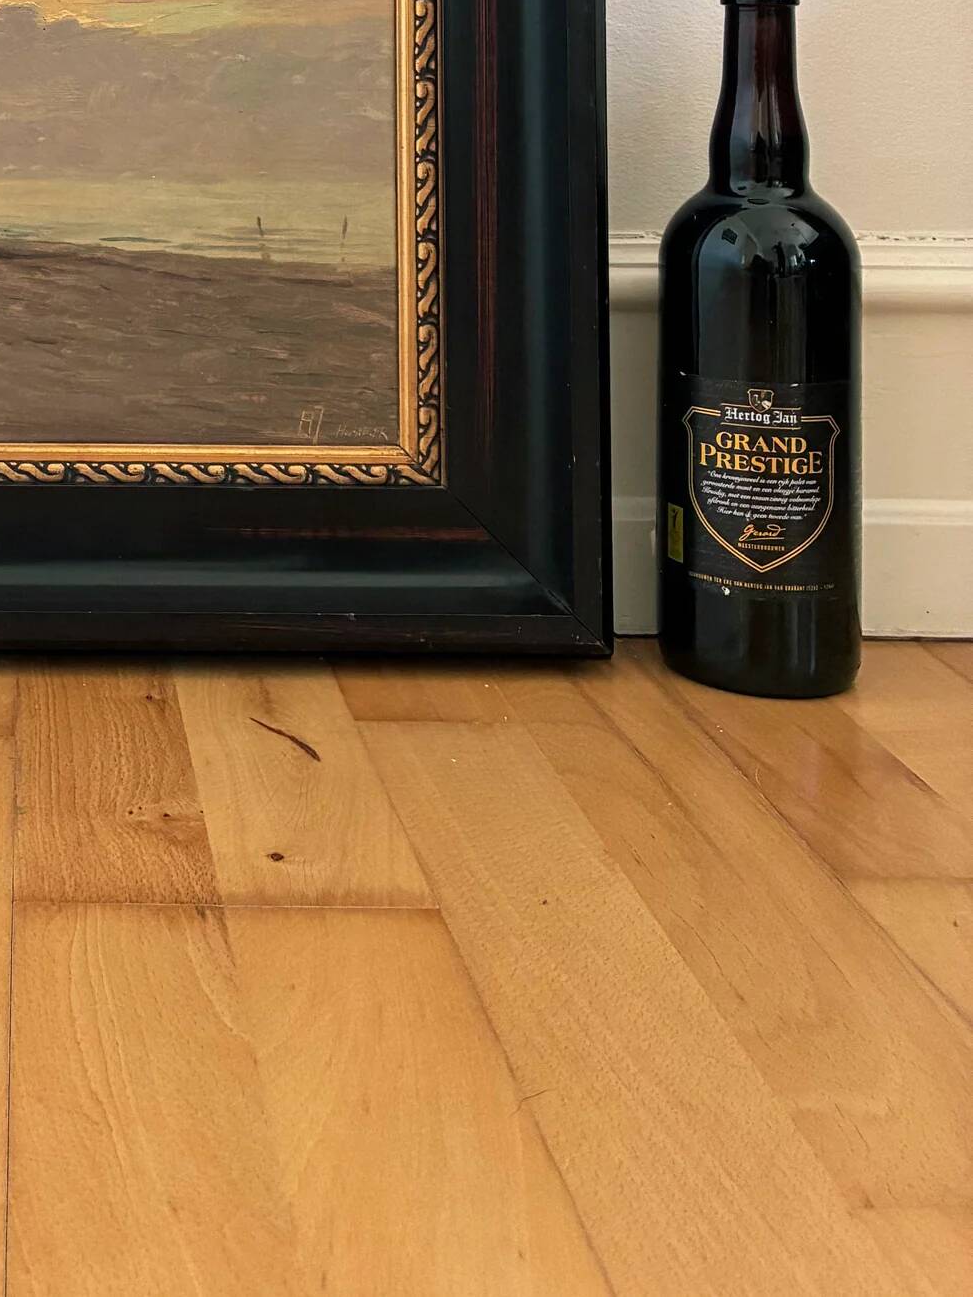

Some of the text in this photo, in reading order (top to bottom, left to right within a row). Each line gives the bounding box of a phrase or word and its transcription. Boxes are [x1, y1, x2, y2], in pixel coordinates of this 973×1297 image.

[724, 406, 798, 425] Hertog Jan
[715, 431, 807, 454] GRAND
[699, 442, 823, 475] PRESTIGE
